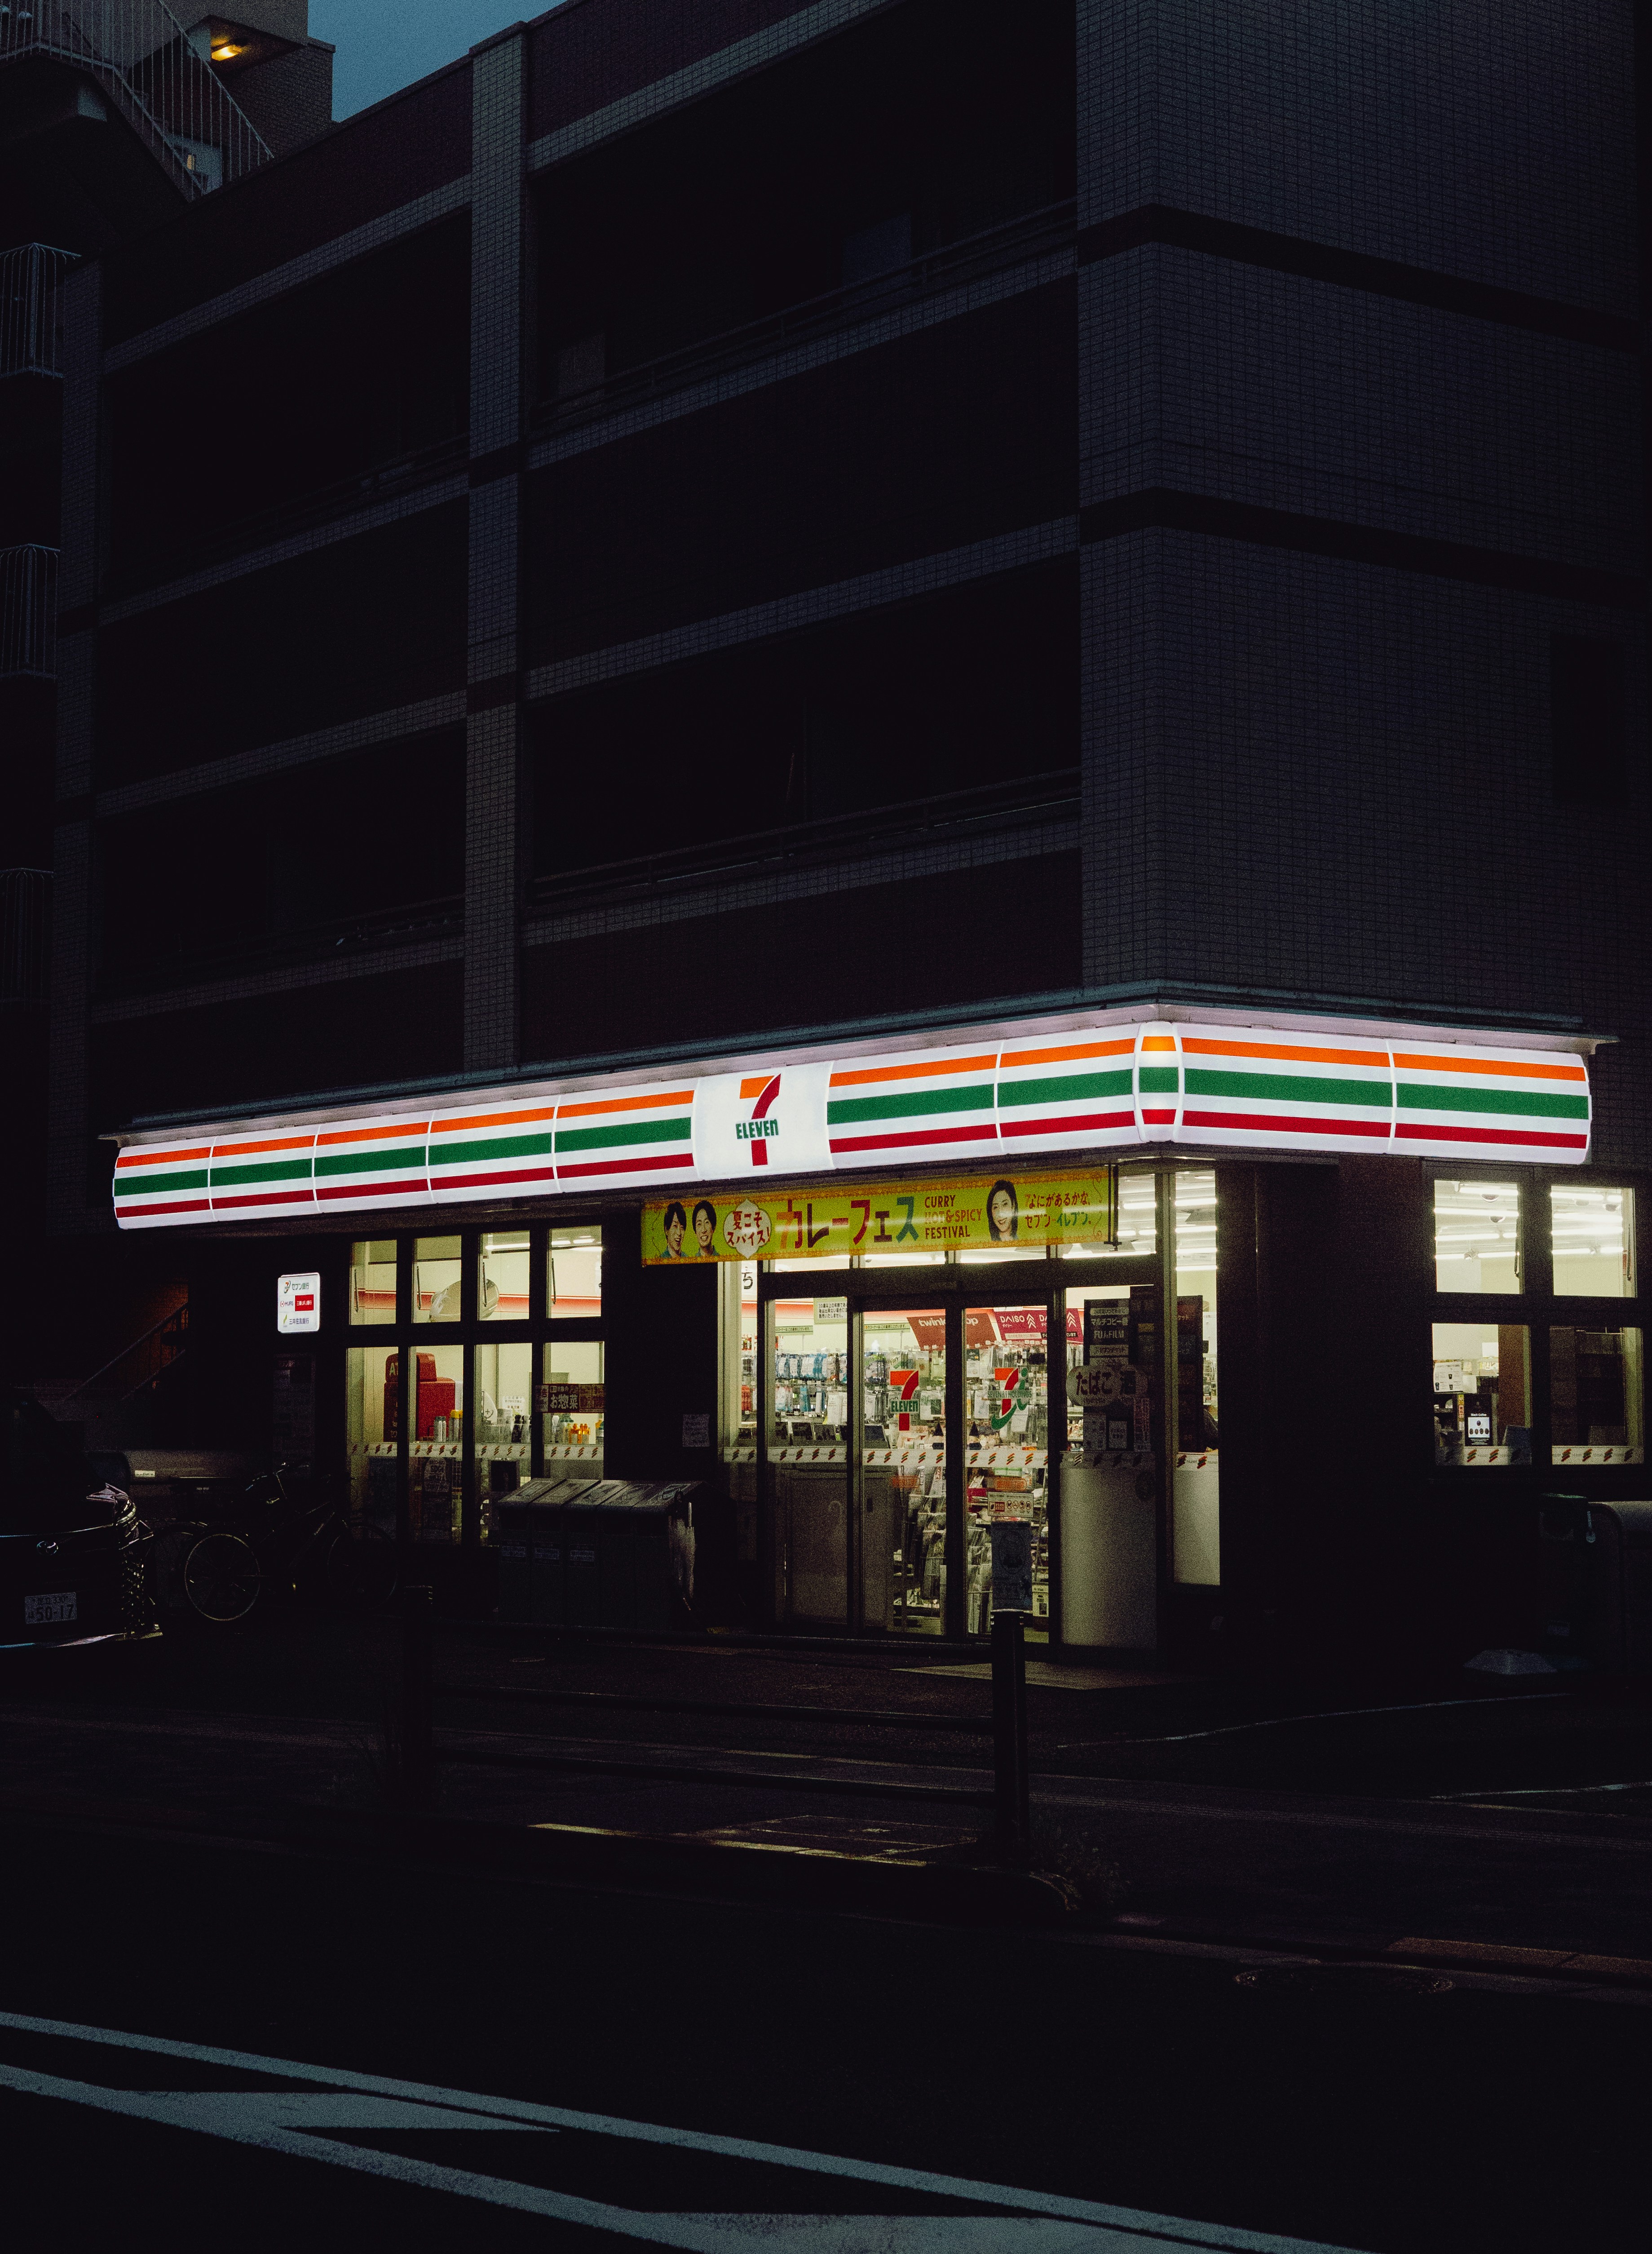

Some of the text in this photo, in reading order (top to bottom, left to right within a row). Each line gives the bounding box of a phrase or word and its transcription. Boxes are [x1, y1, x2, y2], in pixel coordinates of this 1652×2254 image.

[925, 1195, 956, 1208] CURRY
[733, 1210, 762, 1230] 夏こそ
[777, 1196, 919, 1249] カレーフェス
[925, 1225, 971, 1240] FESTIVAL
[1076, 1372, 1112, 1395] たばこ
[550, 1394, 579, 1410] お惣菜
[36, 1604, 74, 1621] 50-17
